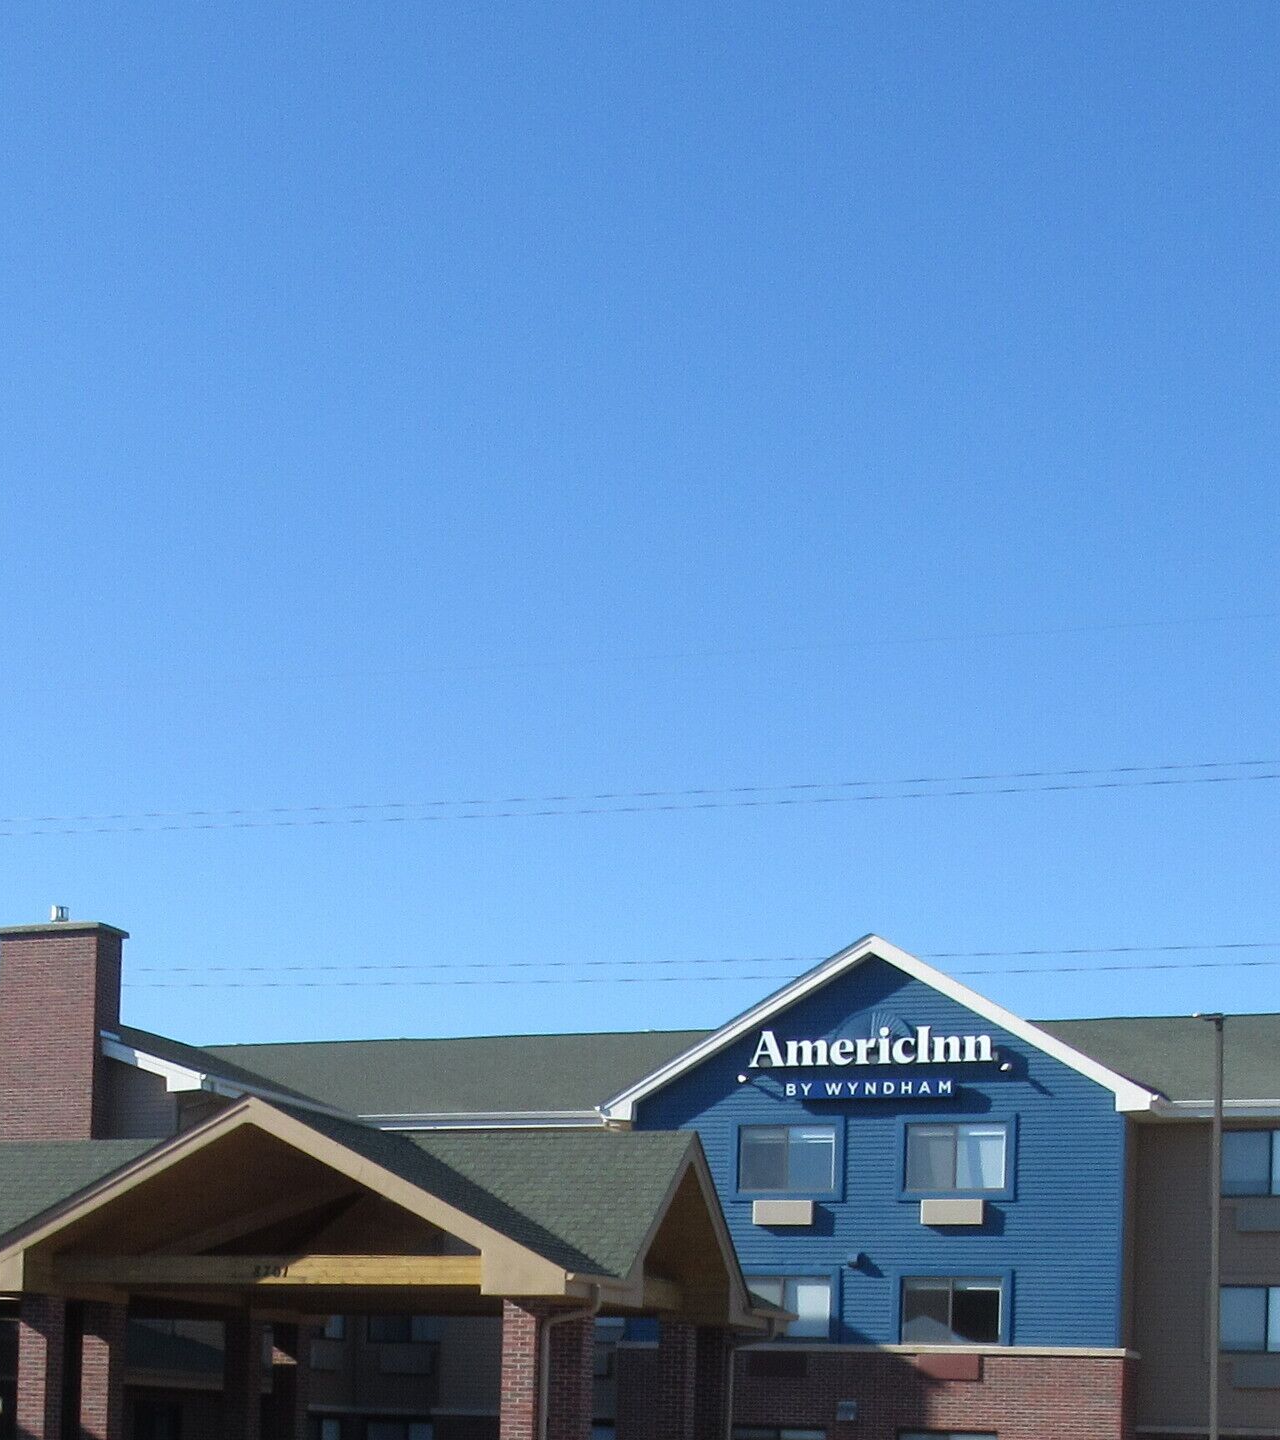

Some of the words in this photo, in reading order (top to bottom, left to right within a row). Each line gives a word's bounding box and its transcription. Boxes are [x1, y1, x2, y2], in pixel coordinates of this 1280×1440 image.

[748, 1025, 993, 1068] AmericInn
[785, 1083, 812, 1097] BY
[824, 1080, 952, 1096] WYNDHAM
